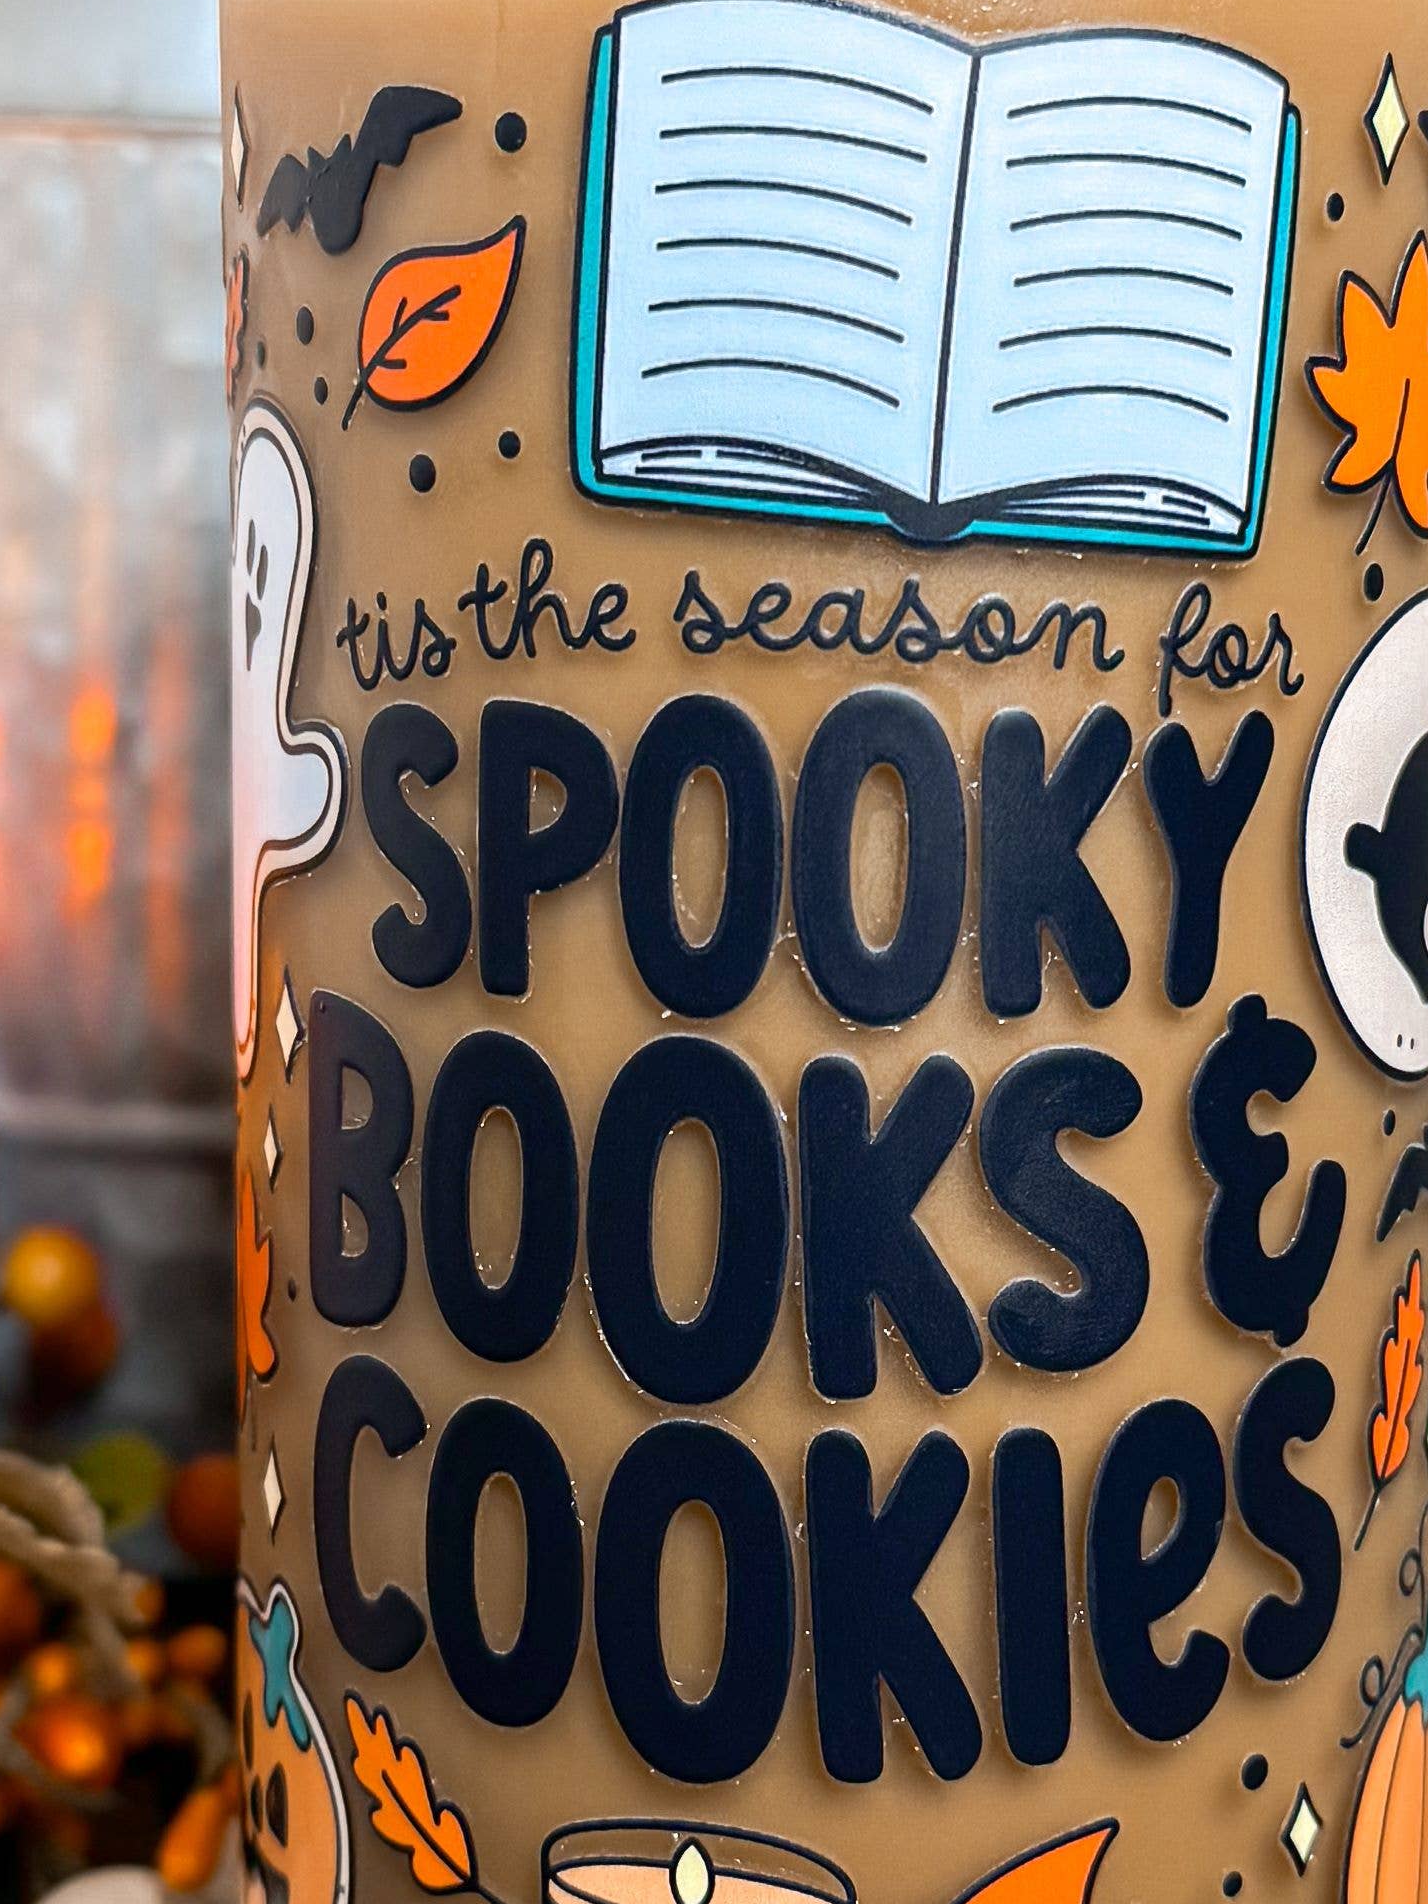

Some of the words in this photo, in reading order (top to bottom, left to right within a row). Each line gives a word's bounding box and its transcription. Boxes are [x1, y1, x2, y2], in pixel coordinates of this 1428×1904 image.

[458, 537, 637, 660] the
[673, 569, 1125, 673] season
[1158, 581, 1306, 715] for
[360, 686, 1275, 1028] SPOOKY
[308, 988, 1150, 1406] BOOKS
[1189, 993, 1346, 1348] &
